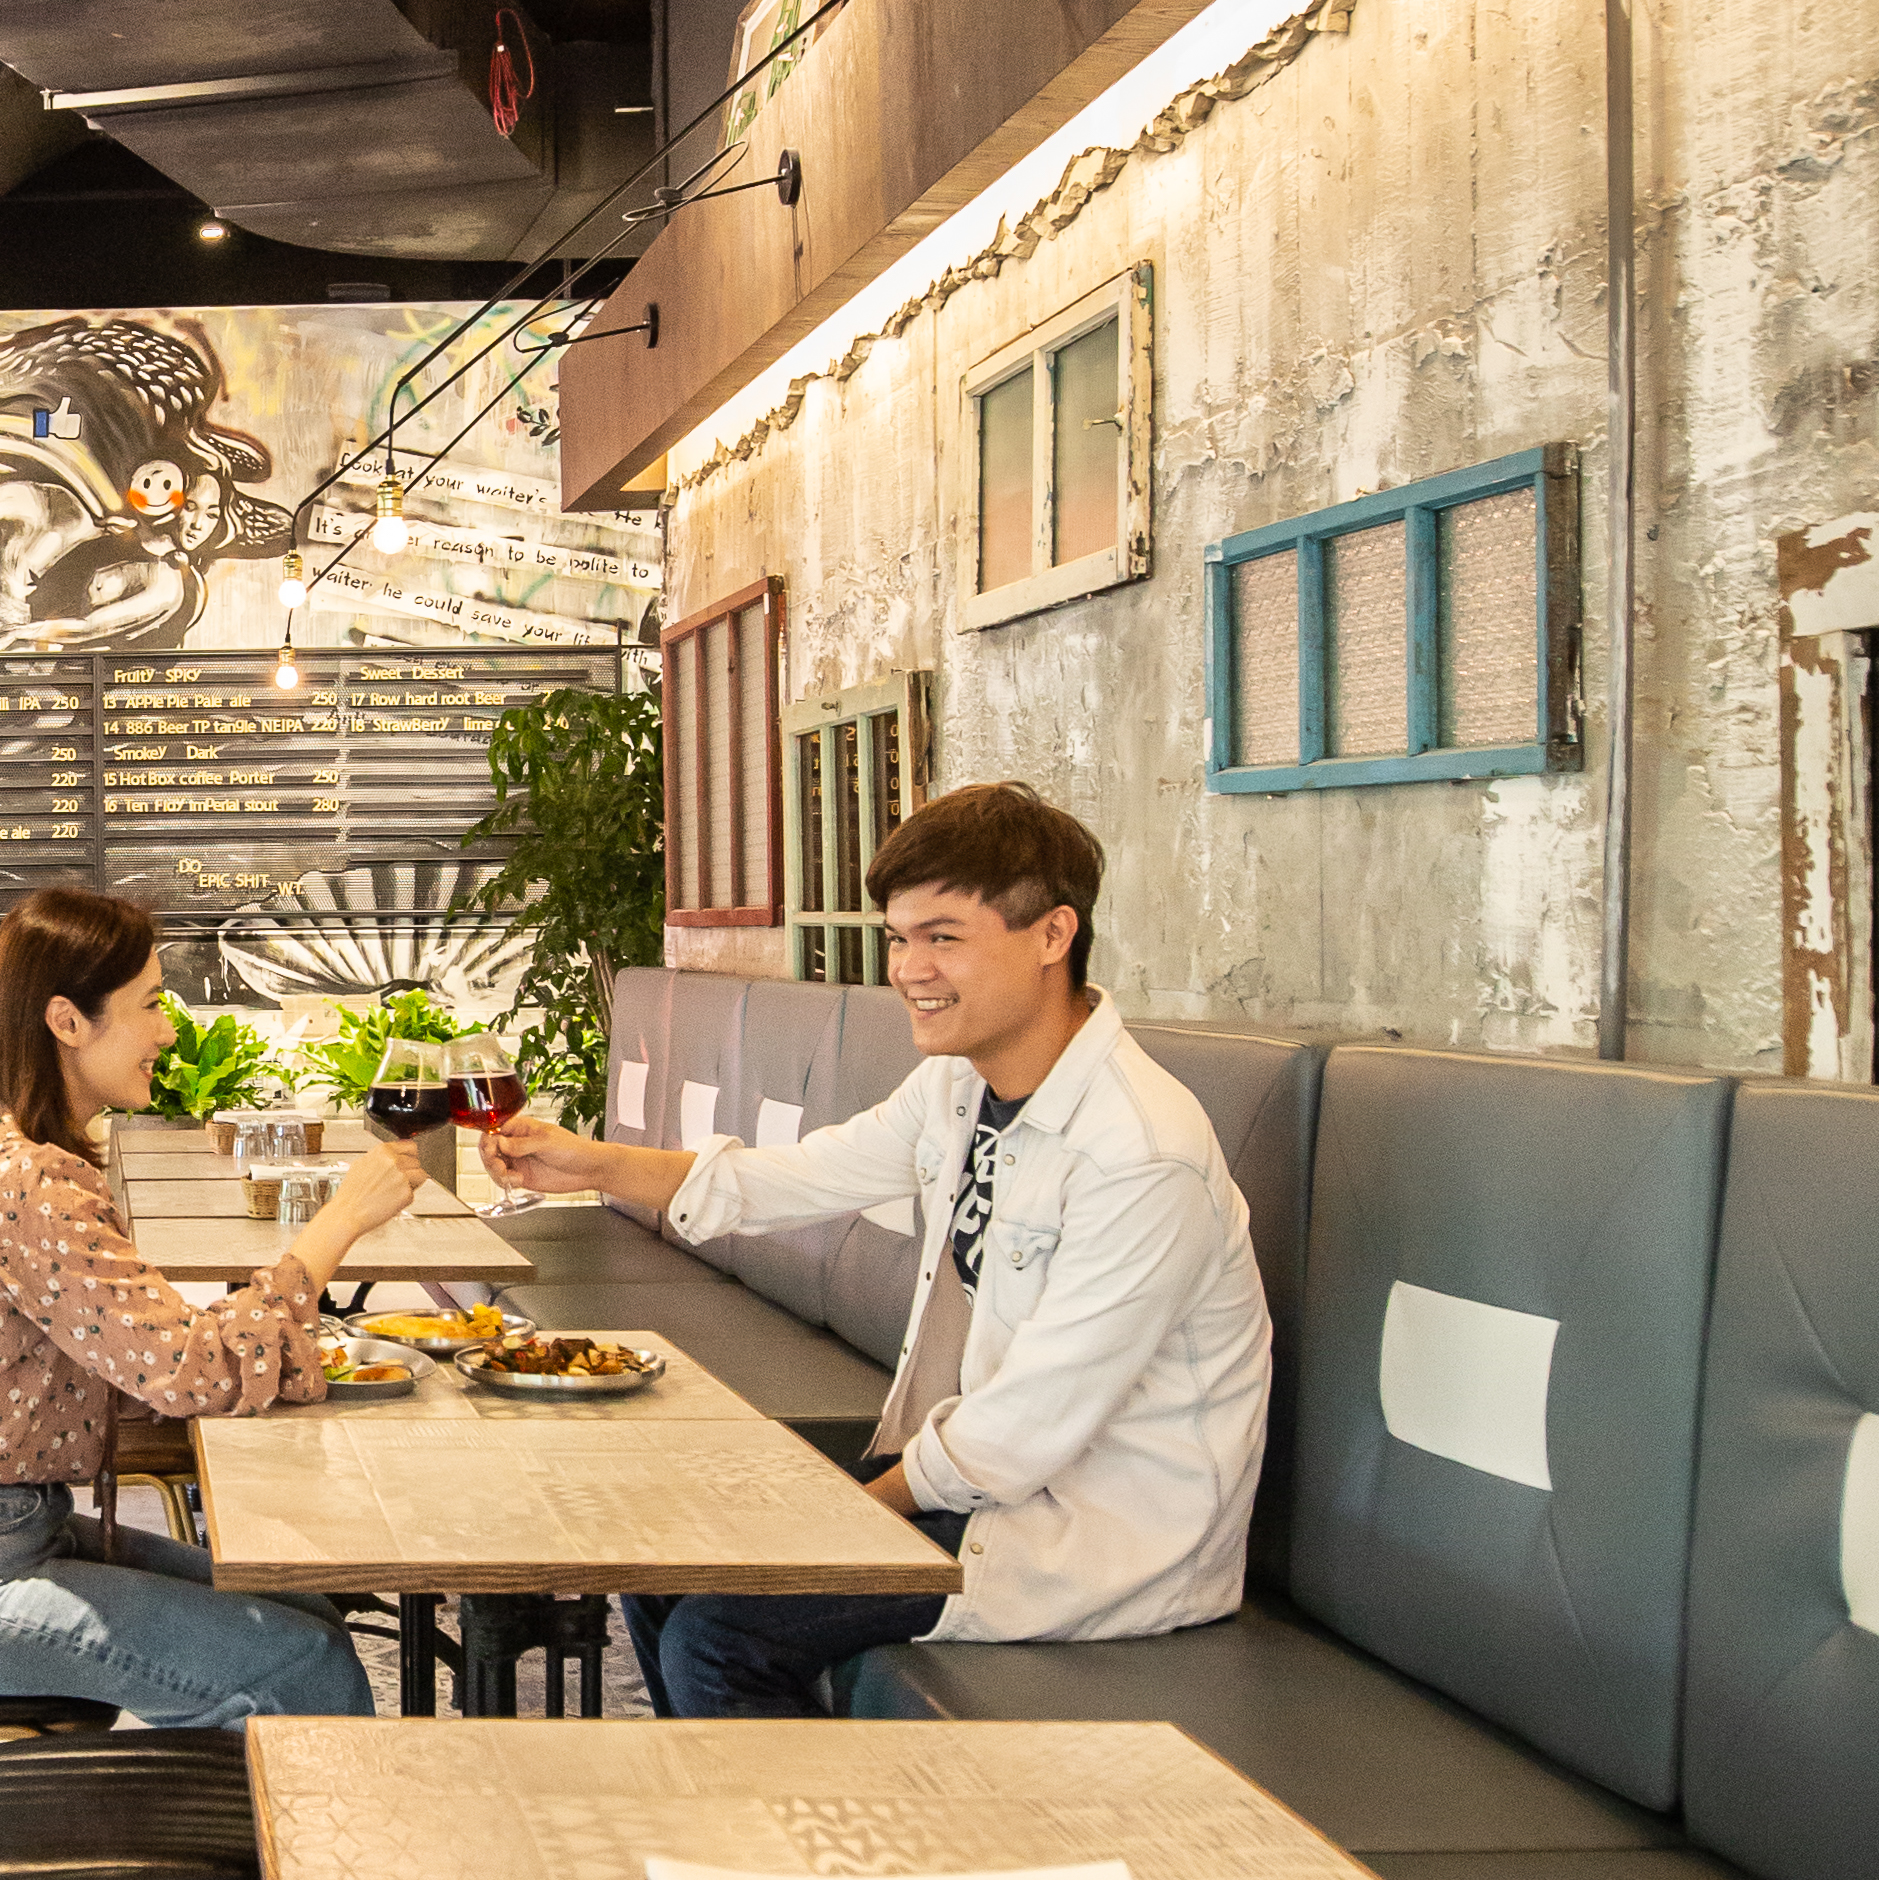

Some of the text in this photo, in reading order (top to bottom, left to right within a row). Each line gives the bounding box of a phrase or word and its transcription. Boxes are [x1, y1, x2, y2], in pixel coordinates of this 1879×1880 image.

[423, 475, 463, 490] your
[316, 516, 342, 536] It's
[433, 539, 494, 559] reason
[508, 545, 525, 562] to
[536, 549, 557, 565] be
[569, 557, 619, 574] polite
[631, 562, 649, 578] to
[383, 582, 403, 599] he
[414, 597, 463, 615] could
[470, 610, 512, 628] save
[522, 623, 563, 642] your
[114, 668, 156, 683] Fruity
[360, 665, 465, 680] Sweet Dessert
[19, 696, 42, 711] IPA
[51, 696, 79, 710] 250
[103, 695, 117, 709] 13
[194, 694, 223, 708] Pale
[229, 694, 252, 708] ale
[311, 691, 338, 706] 250
[351, 690, 506, 706] 17 Row hard root Beer
[103, 720, 119, 735] 14
[126, 720, 153, 735] 886
[157, 720, 190, 734] Beer
[261, 718, 304, 733] NEIPA
[311, 718, 338, 732] 220
[351, 718, 365, 732] 18
[51, 747, 77, 761] 250
[113, 745, 219, 760] Smokey Dark
[51, 773, 78, 787] 220
[103, 772, 117, 786] 15
[179, 771, 223, 785] coffee
[229, 770, 275, 785] Porter
[313, 769, 339, 784] 250
[52, 799, 79, 813] 220
[103, 799, 117, 813] 16
[125, 798, 149, 812] Ten
[245, 798, 279, 812] stout
[312, 797, 339, 812] 280
[11, 825, 31, 840] ale
[52, 825, 79, 839] 220
[178, 859, 202, 873] DO
[199, 873, 270, 888] EPIC SHIT
